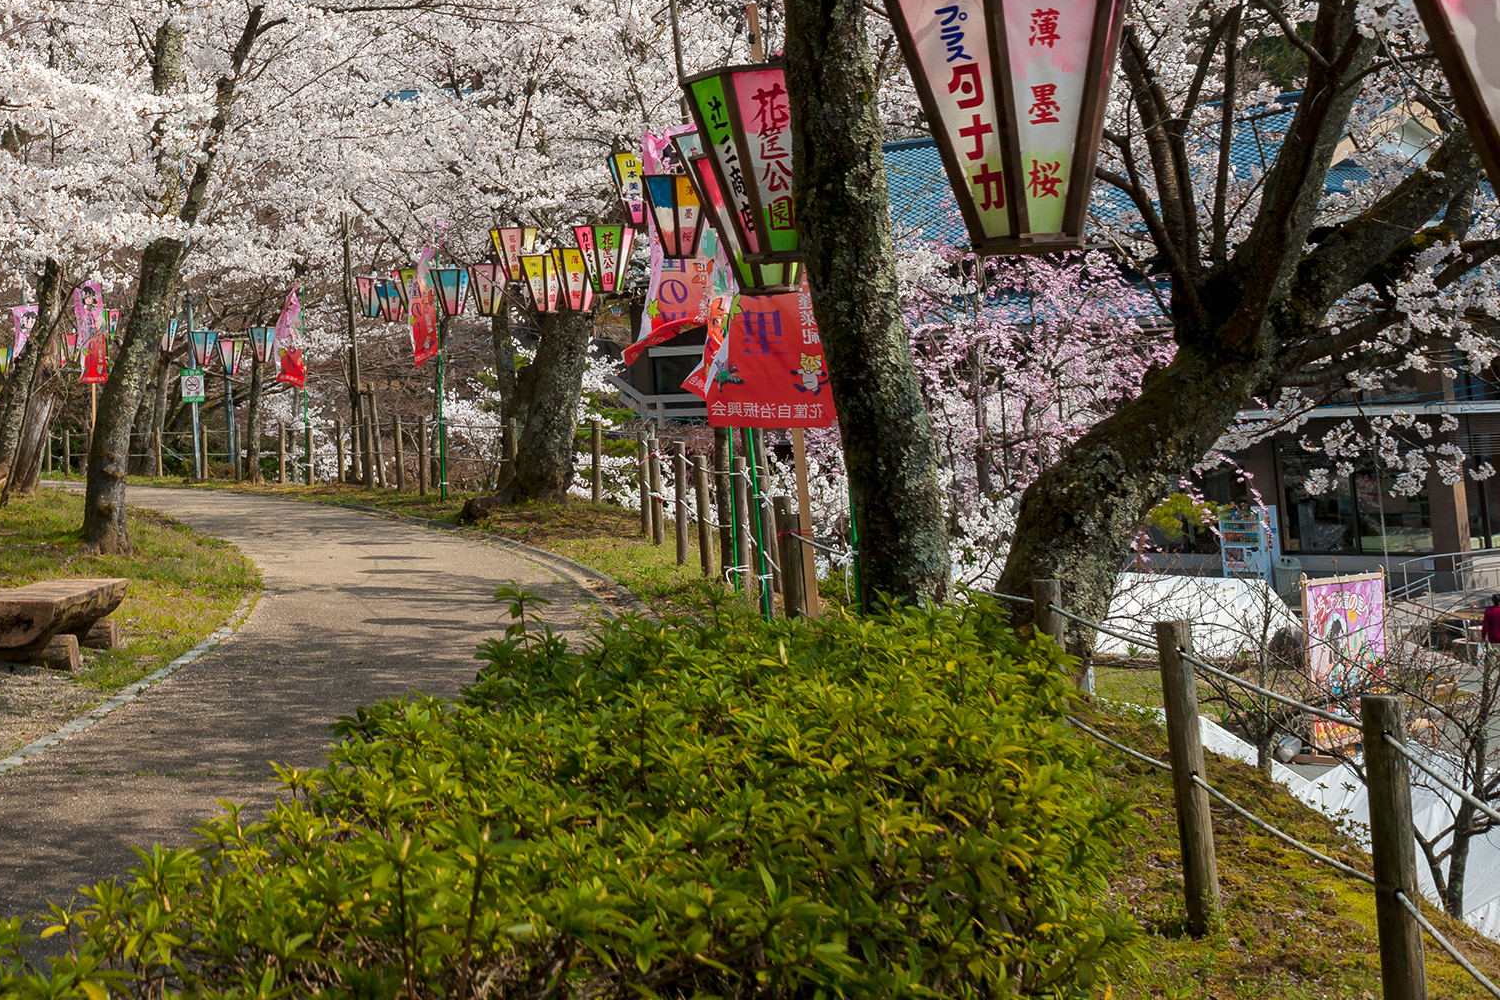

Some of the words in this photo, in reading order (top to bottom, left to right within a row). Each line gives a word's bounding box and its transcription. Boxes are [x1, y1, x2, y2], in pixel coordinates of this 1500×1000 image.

[751, 83, 794, 230] 花筐公園
[934, 5, 1005, 211] プラスタナカ
[1026, 7, 1063, 199] 薄墨桜
[571, 255, 581, 300] 薄墨桜
